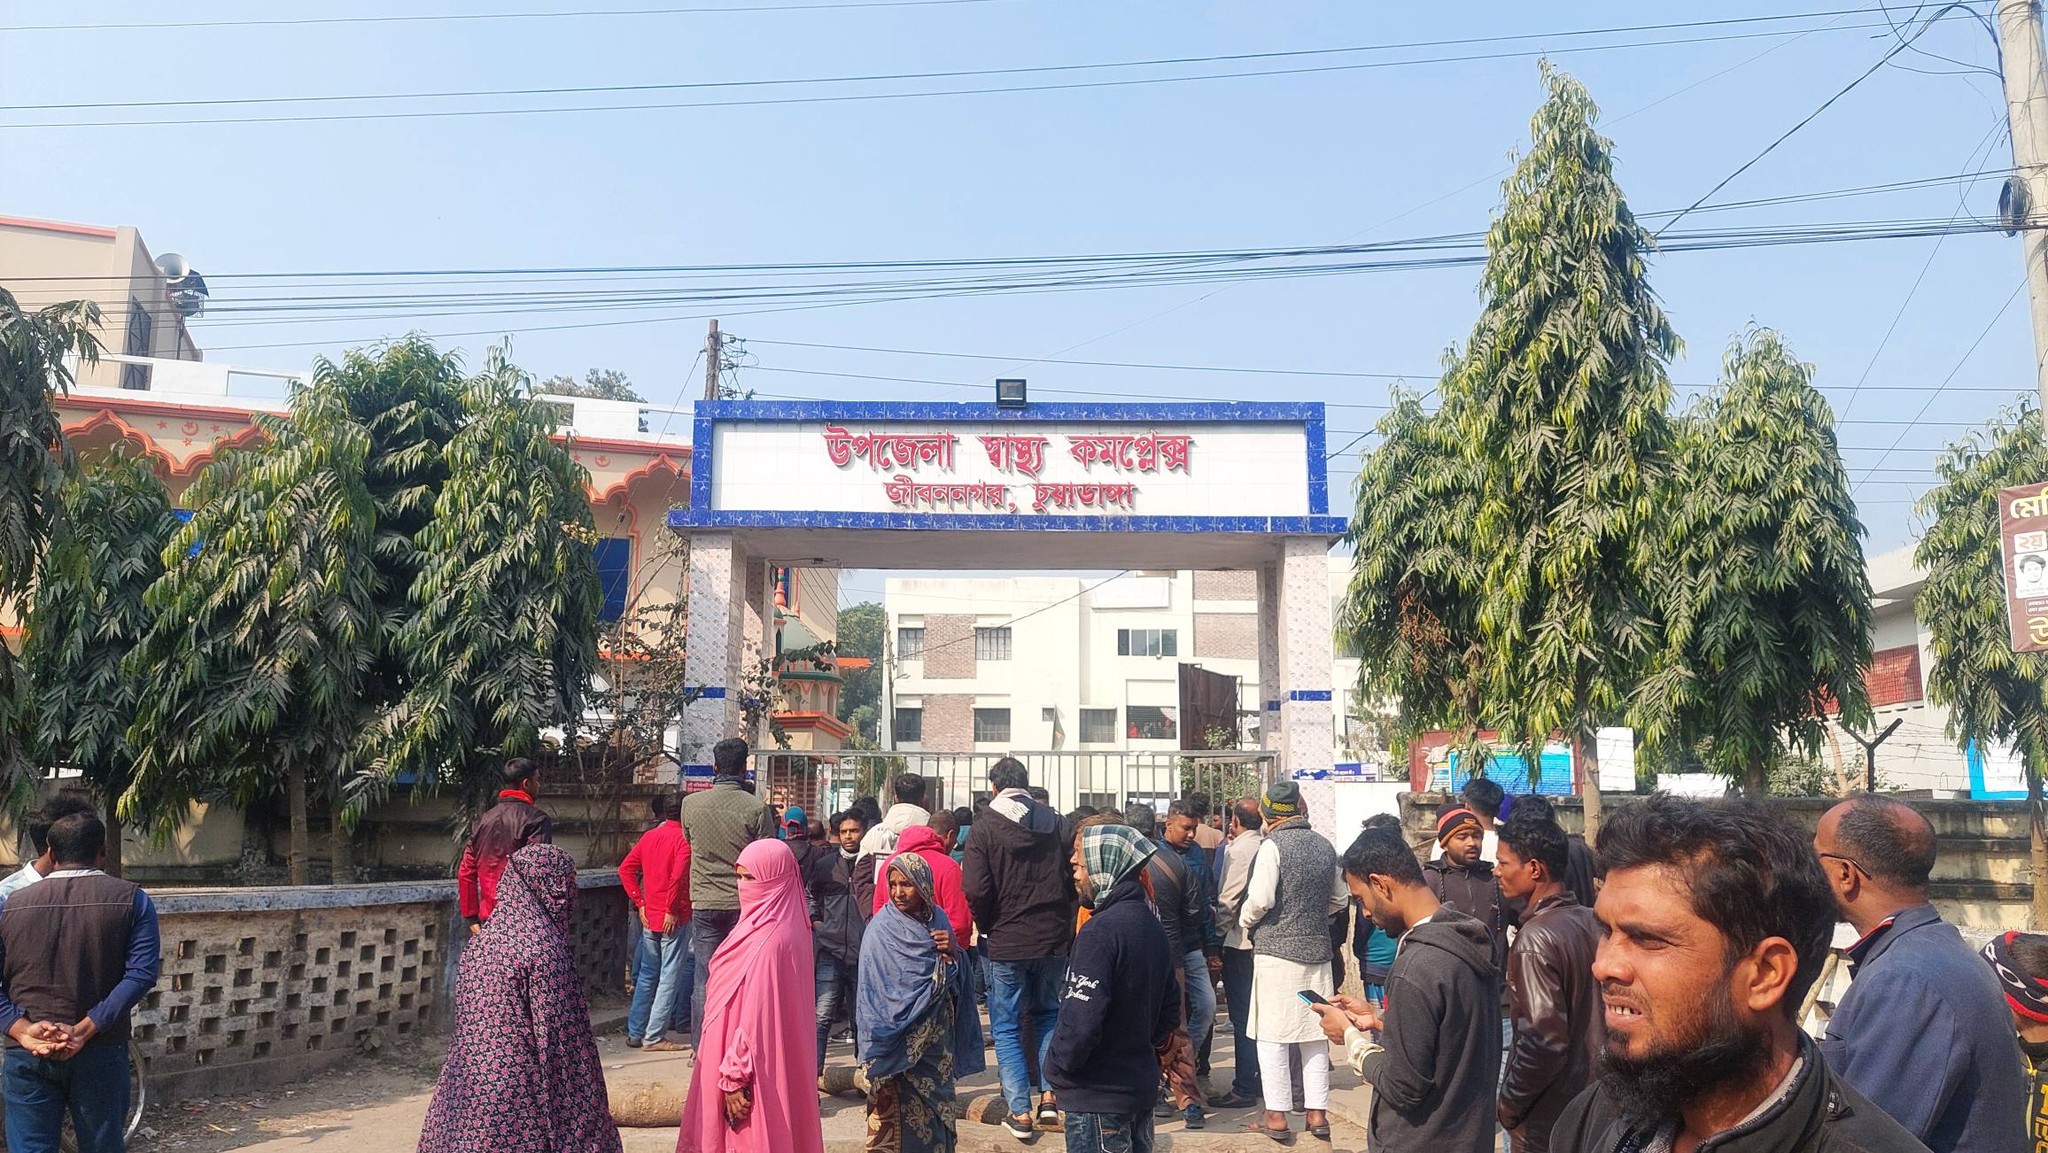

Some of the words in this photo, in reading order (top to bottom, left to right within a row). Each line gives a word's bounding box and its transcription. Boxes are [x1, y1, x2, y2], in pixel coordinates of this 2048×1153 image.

[822, 423, 957, 470] উপজেলা
[975, 432, 1049, 479] স্বাস্থ্য
[1065, 430, 1193, 472] কমপ্লেক্স
[882, 473, 1018, 512] জীবননগর,
[1031, 481, 1136, 512] চুয়াডাঙ্গা
